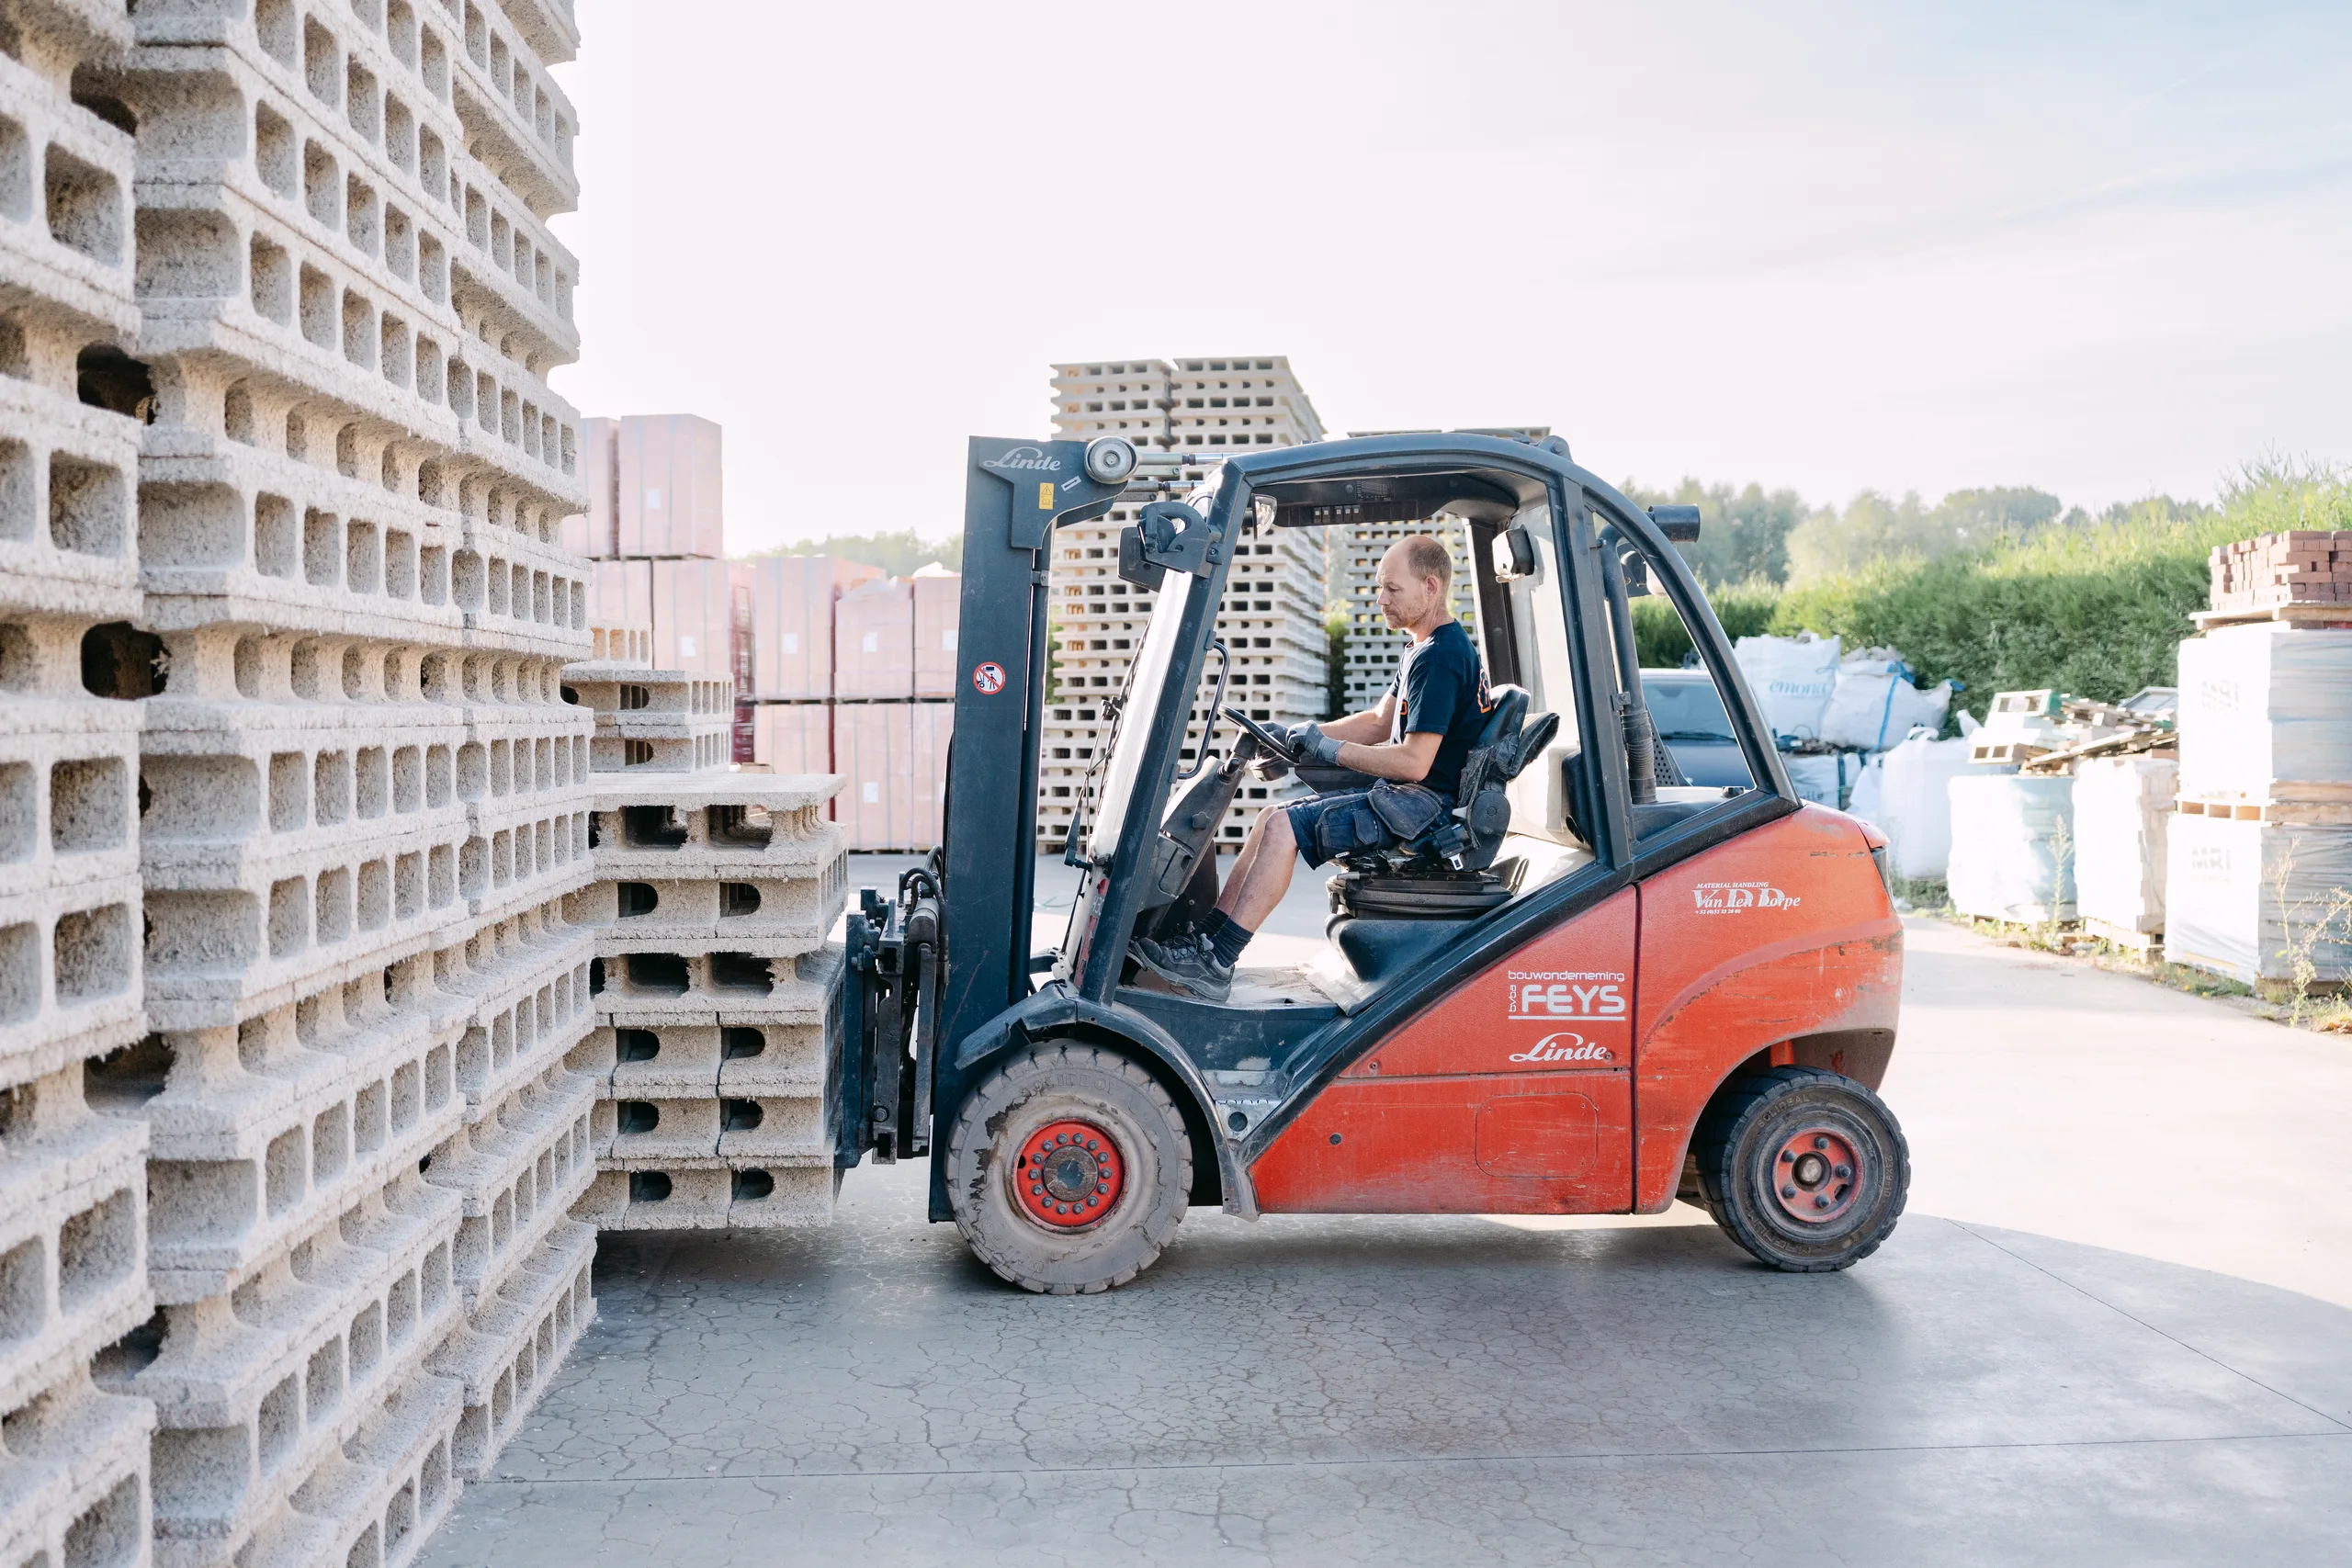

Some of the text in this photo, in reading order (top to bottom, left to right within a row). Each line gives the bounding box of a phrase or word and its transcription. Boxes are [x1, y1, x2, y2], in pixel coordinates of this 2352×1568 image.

[982, 446, 1061, 471] Linde
[1690, 888, 1723, 908] Van
[1757, 887, 1801, 910] Dorpe
[1508, 970, 1625, 982] bouwonderneming
[1508, 984, 1517, 1012] bvba
[1521, 984, 1625, 1013] FEYS
[1509, 1032, 1608, 1062] Linde
[1757, 1093, 1810, 1128] SOLIDEAL
